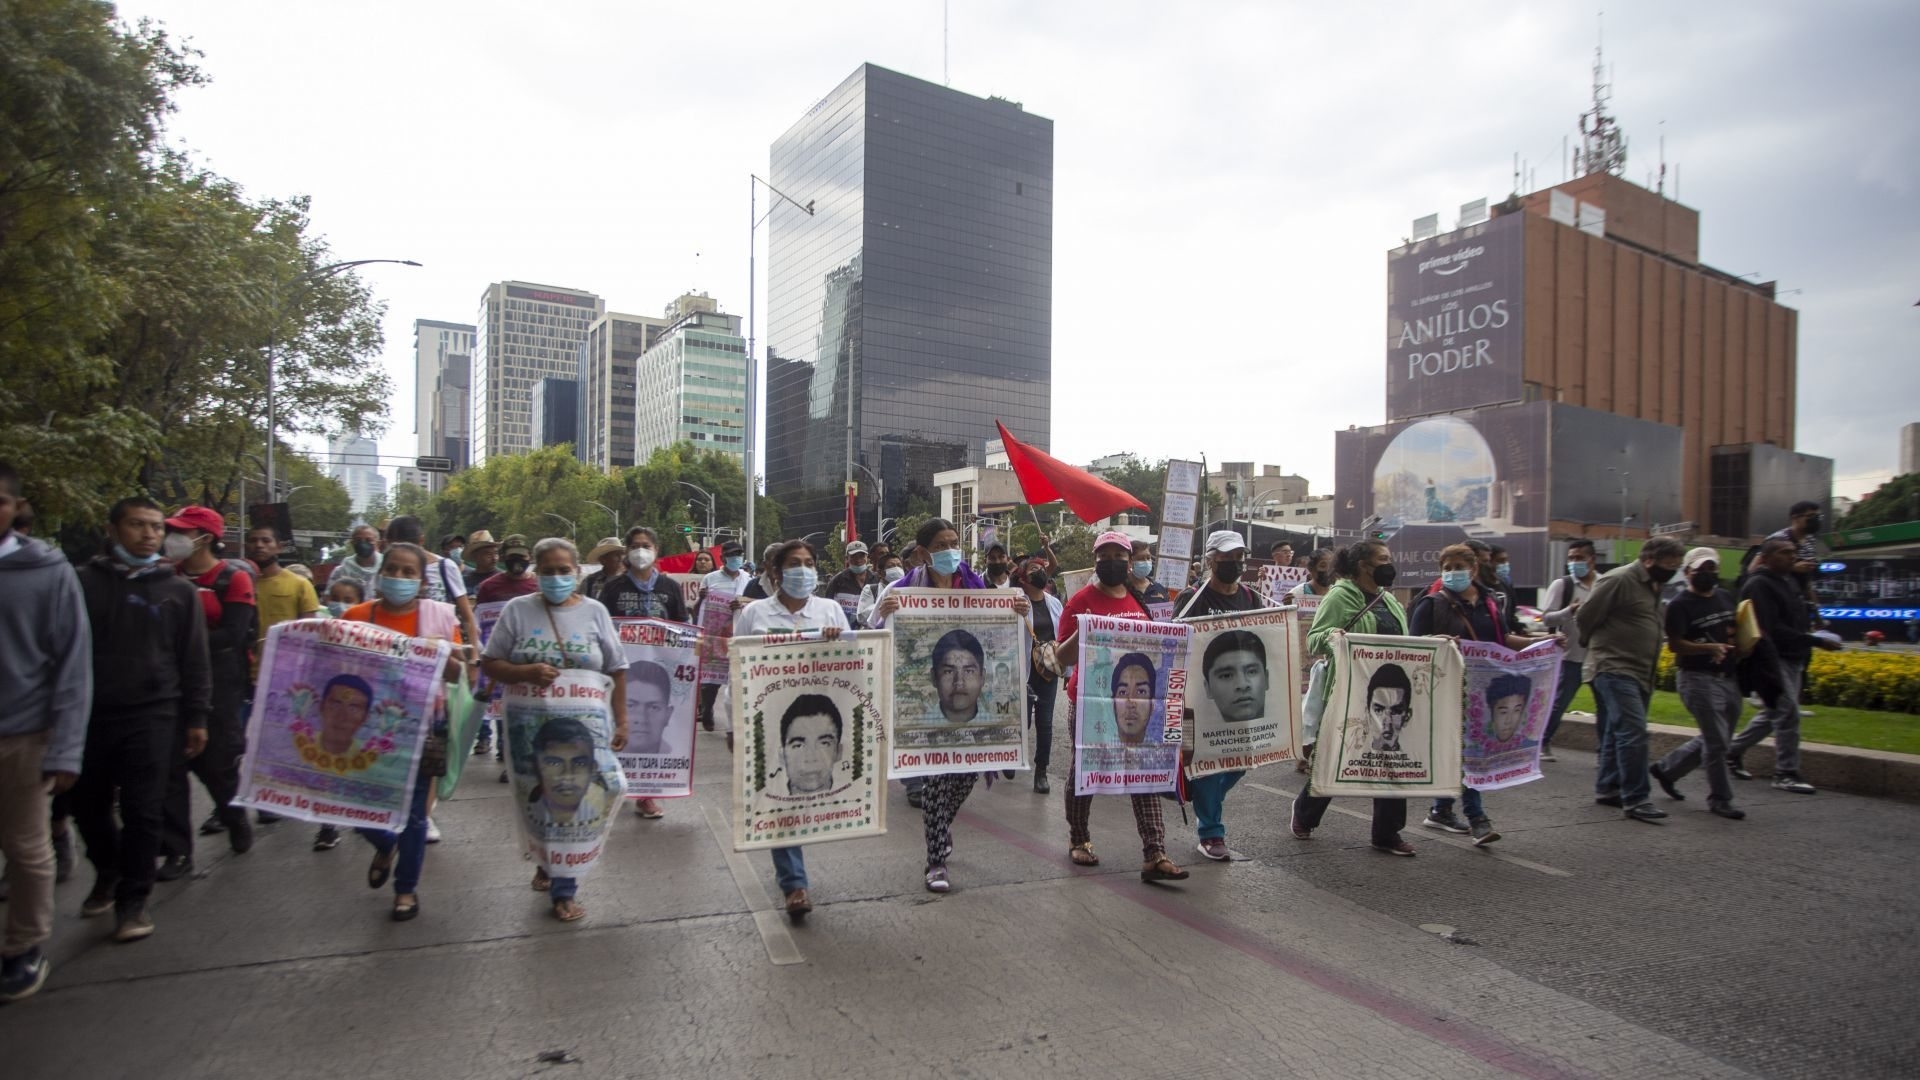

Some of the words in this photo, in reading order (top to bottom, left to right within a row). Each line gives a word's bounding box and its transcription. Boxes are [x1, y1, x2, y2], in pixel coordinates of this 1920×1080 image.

[1418, 255, 1451, 274] prime
[1452, 246, 1485, 261] video
[1398, 299, 1509, 349] ANILLOS
[1408, 339, 1494, 380] PODER
[932, 598, 945, 609] se
[948, 596, 960, 609] lo
[1088, 618, 1115, 632] ¡Vivo
[1118, 621, 1130, 632] se
[1133, 621, 1143, 633] lo
[1146, 623, 1187, 637] llevaron!
[1213, 622, 1224, 631] se
[1240, 613, 1285, 628] llevaron!
[350, 625, 393, 648] FALTAN
[620, 624, 637, 643] NOS
[637, 624, 665, 647] FALTAN
[1353, 649, 1374, 661] ¡Vivo
[1375, 652, 1384, 660] se
[1385, 650, 1393, 660] lo
[1395, 650, 1432, 662] llevaron!
[674, 664, 697, 682] 43
[750, 663, 781, 680] ¡Vivo
[783, 665, 796, 676] se
[798, 662, 810, 675] lo
[811, 659, 864, 674] llevaron!
[1168, 669, 1186, 690] NOS
[531, 686, 546, 698] se
[551, 684, 566, 698] lo
[782, 674, 830, 689] MONTAÑAS
[831, 677, 851, 689] POR
[849, 684, 887, 743] ENCONTRARTE
[1166, 692, 1184, 727] FALTAN
[1163, 727, 1182, 743] 43!
[1203, 728, 1236, 739] MARTÍN
[1238, 723, 1279, 735] GETSEMANY
[1209, 736, 1252, 747] SÁNCHEZ
[1251, 732, 1277, 742] GARCÍA
[638, 757, 659, 769] TIZAPA
[897, 753, 921, 768] ¡Con
[924, 752, 950, 765] VIDA
[952, 751, 963, 764] lo
[965, 749, 1018, 766] queremos!
[1195, 759, 1216, 773] ¡Con
[1218, 757, 1243, 769] VIDA
[1244, 754, 1253, 767] lo
[1253, 747, 1291, 766] queremos!
[1086, 771, 1112, 788] ¡Vivo
[1114, 772, 1122, 784] lo
[1123, 770, 1170, 787] queremos!
[1341, 767, 1359, 778] ¡Con
[1360, 768, 1379, 777] VIDA
[1379, 770, 1387, 778] lo
[1387, 770, 1427, 780] queremos!
[254, 788, 293, 807] ¡Vivo
[295, 795, 309, 809] lo
[312, 801, 393, 826] queremos!
[754, 820, 775, 833] ¡Con
[777, 816, 801, 828] VIDA
[802, 814, 811, 825] lo
[813, 807, 862, 824] queremos!
[550, 851, 562, 865] lo
